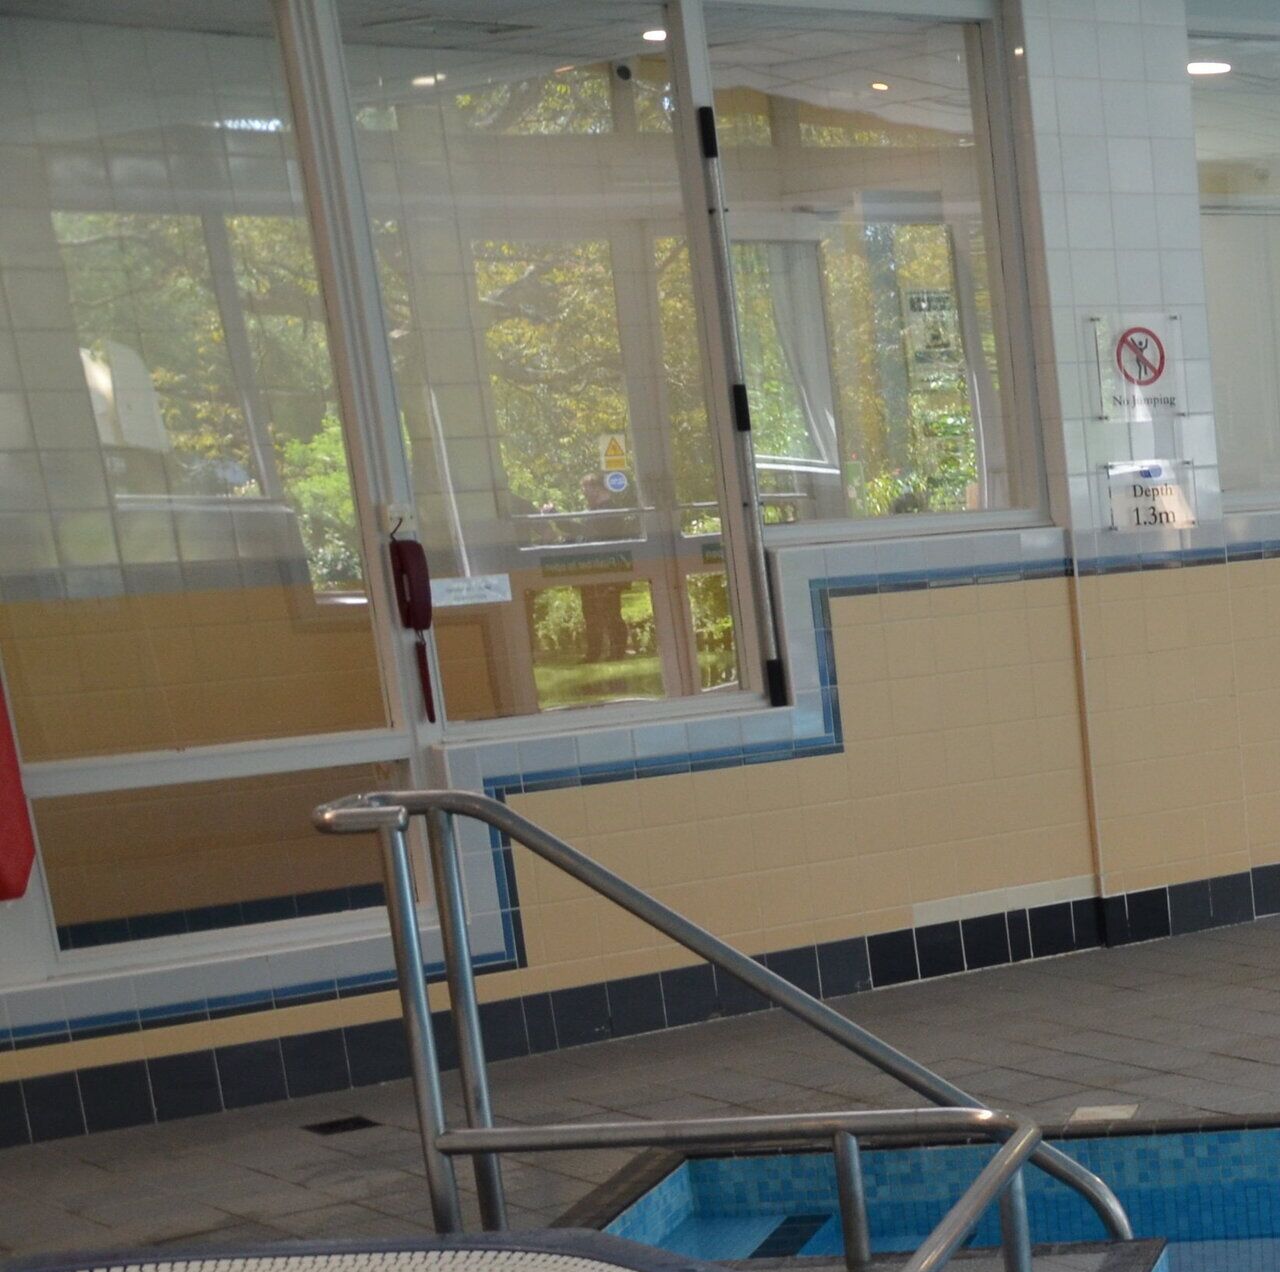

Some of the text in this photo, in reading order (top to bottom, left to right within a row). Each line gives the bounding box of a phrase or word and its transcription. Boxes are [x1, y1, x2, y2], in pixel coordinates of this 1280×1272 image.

[1112, 394, 1176, 409] No Jumping
[1132, 484, 1173, 502] Depth
[1133, 507, 1176, 526] 1.3m
